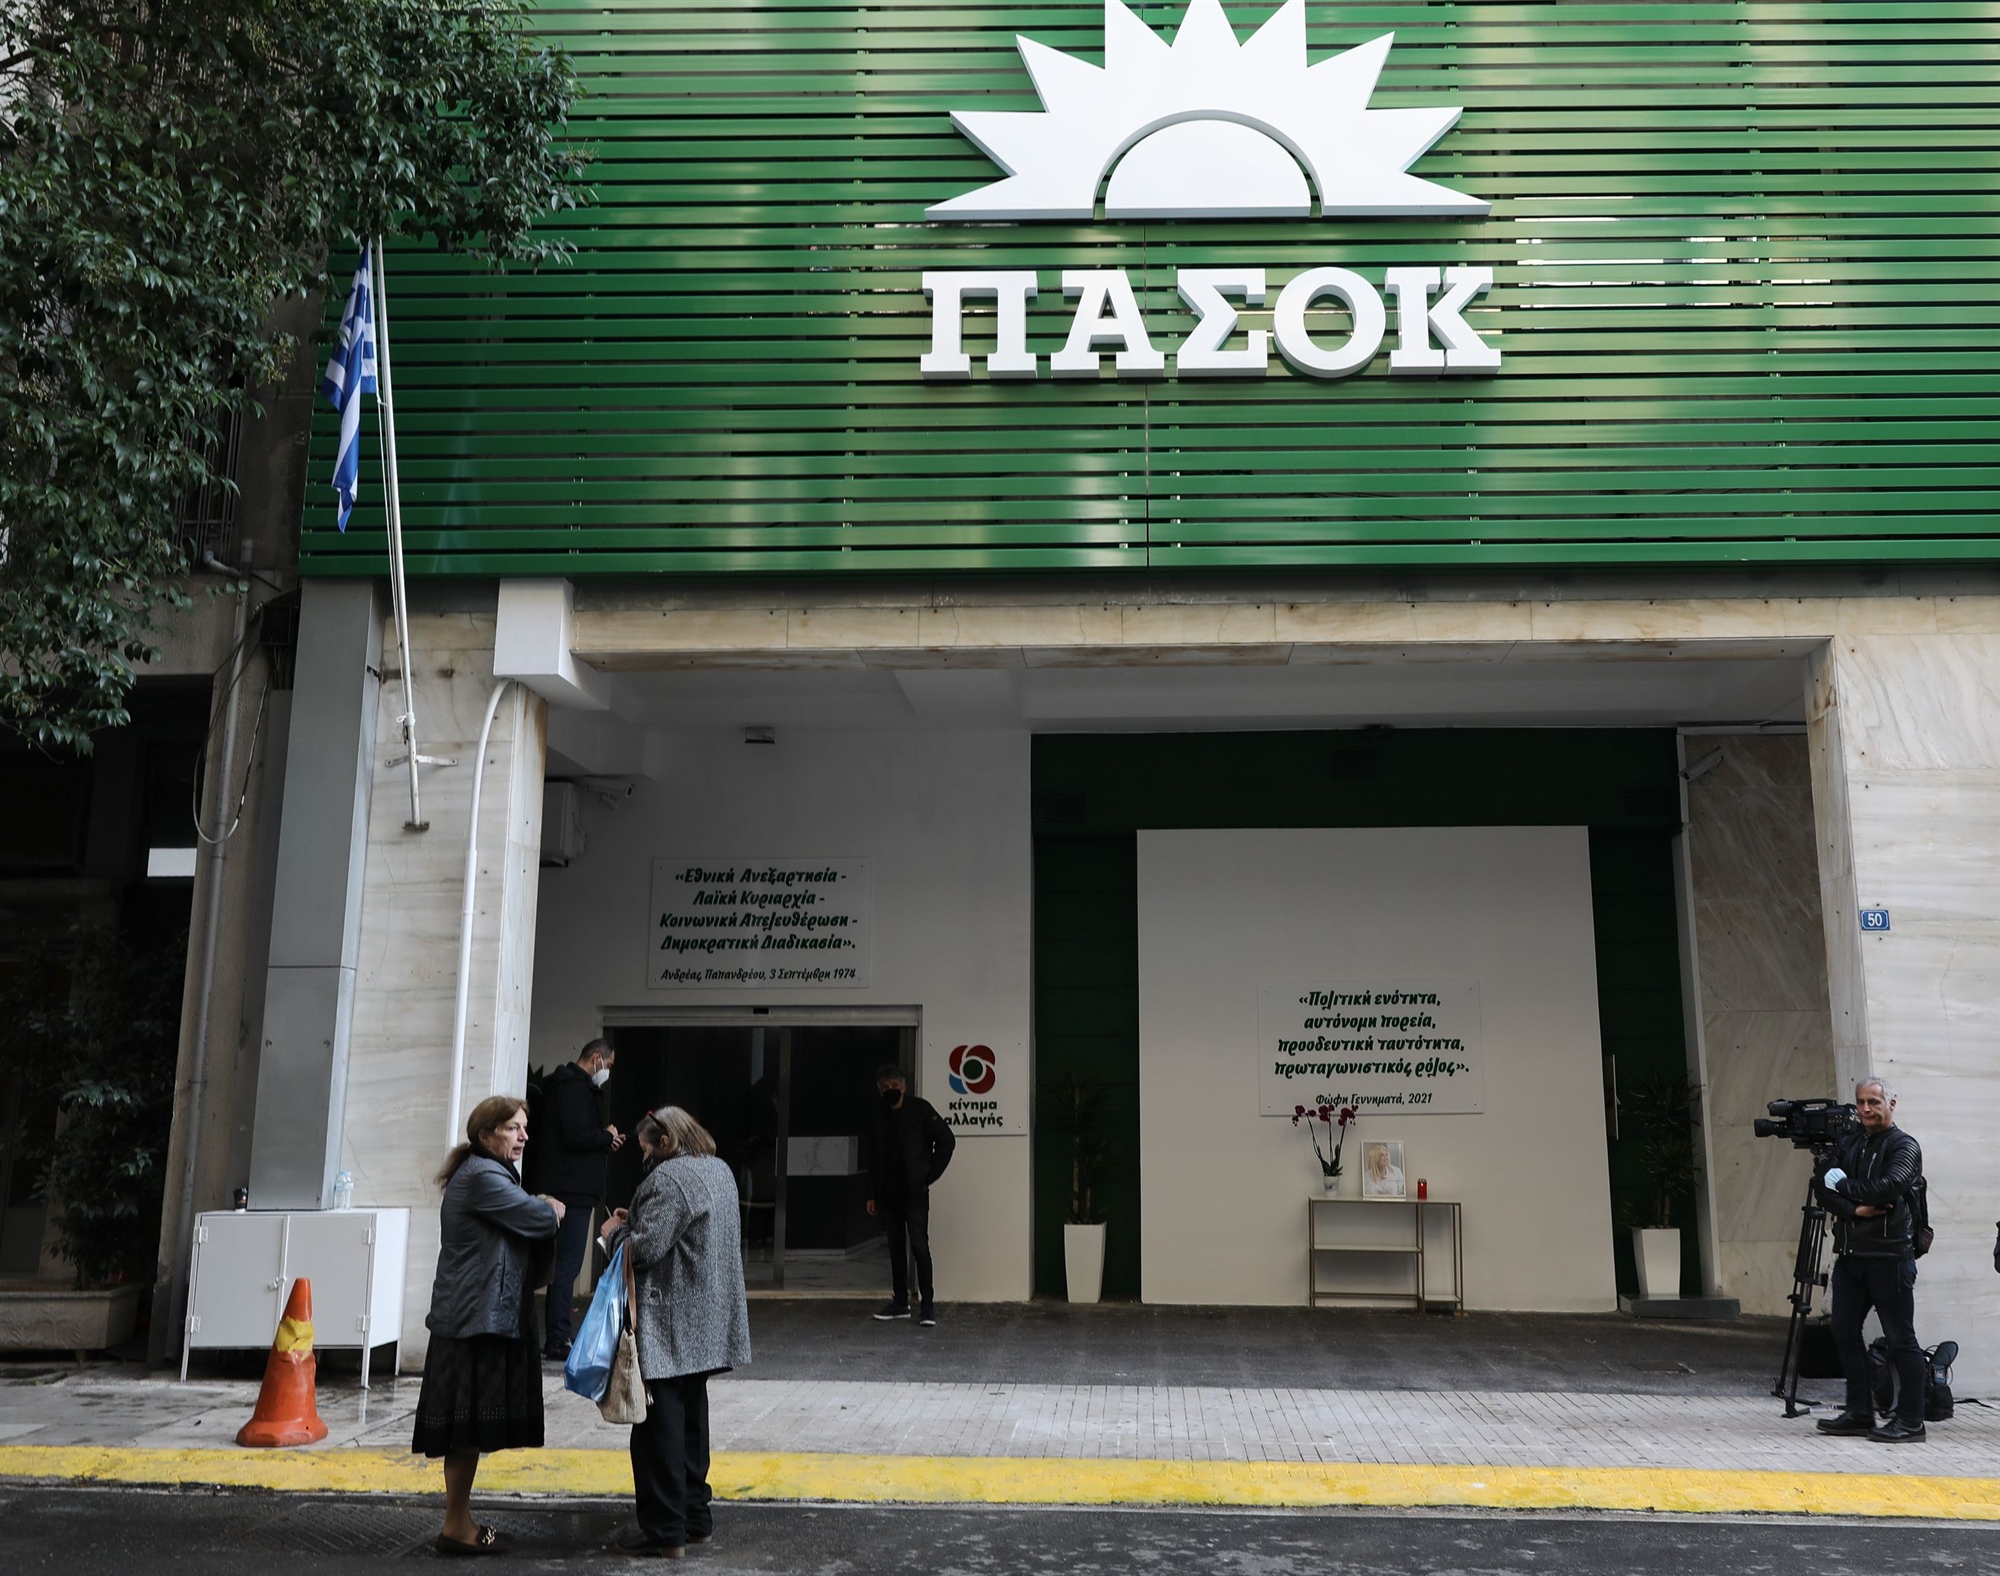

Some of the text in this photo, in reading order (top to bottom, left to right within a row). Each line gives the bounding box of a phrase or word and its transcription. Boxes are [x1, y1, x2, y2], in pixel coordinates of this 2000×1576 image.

[920, 266, 1502, 378] ΠΑΣΟΚ
[675, 867, 734, 883] «Εθνική
[739, 867, 837, 886] Ανεξαρτησία
[693, 890, 738, 905] Λαϊκή
[739, 889, 816, 909] Κυριαρχία
[659, 912, 737, 928] Κοινωνική
[739, 912, 849, 932] Απελευθέρωση
[1867, 912, 1883, 927] 50
[660, 934, 856, 954] Δημοκρατική Διαδικασία».
[661, 968, 856, 983] Ανδρέας Παπανδρέου, 3 Σεπτέμβρη 1974
[1298, 989, 1441, 1010] «Πολιτική ενότητα,
[1304, 1012, 1436, 1032] αυτόνομη πορεία,
[1277, 1034, 1465, 1056] προοδευτική ταυτότητα,
[1274, 1057, 1413, 1079] πρωταγωνιστικός
[949, 1098, 998, 1113] κίνημα
[1315, 1092, 1433, 1108] Φώφη Γεννηματά, 2021
[943, 1112, 1003, 1128] αλλαγής
